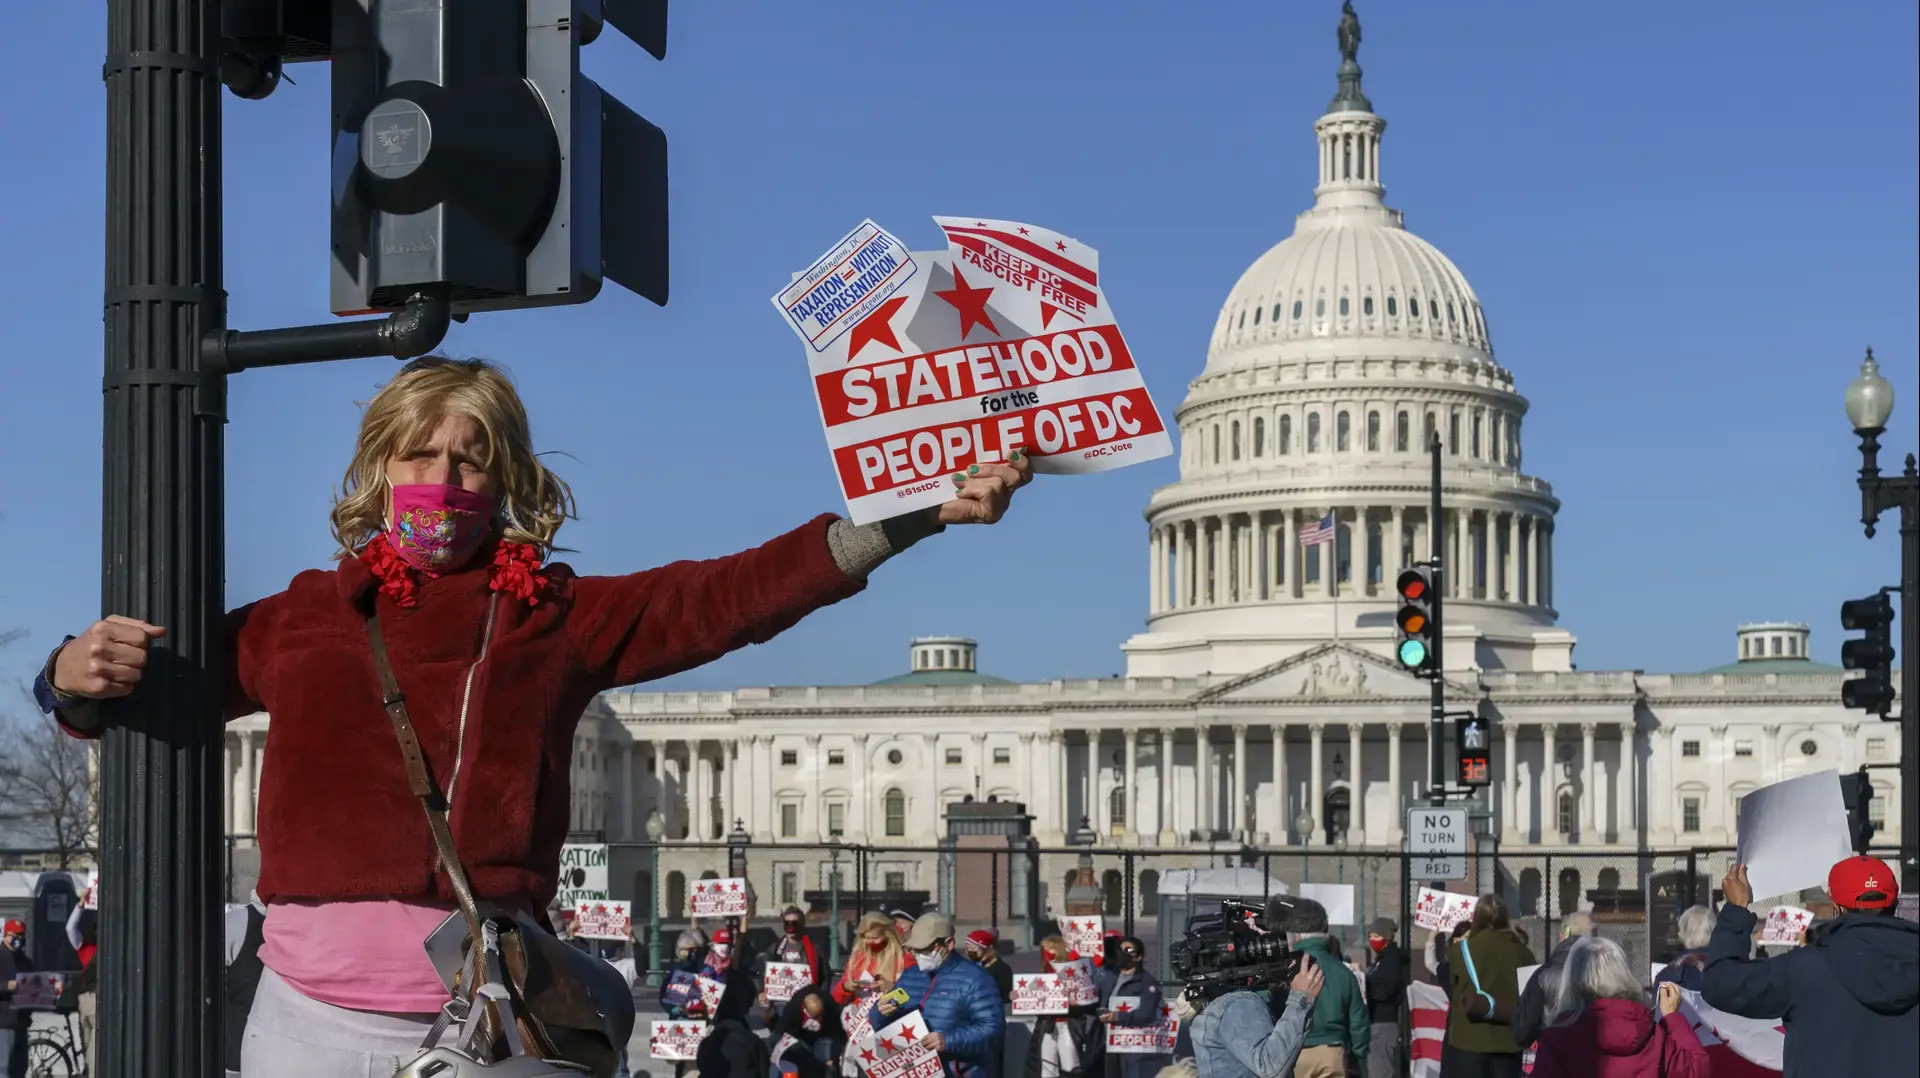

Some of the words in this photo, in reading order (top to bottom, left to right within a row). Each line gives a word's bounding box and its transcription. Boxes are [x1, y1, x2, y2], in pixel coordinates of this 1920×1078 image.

[806, 248, 851, 284] Washington,
[984, 243, 1032, 274] KEEP
[1038, 268, 1063, 289] DC
[791, 273, 846, 322] TAXATION
[850, 235, 893, 273] WITHOUT
[814, 253, 898, 327] REPRESENTATION
[962, 247, 1035, 291] FASCIST
[1041, 284, 1086, 315] FREE
[842, 281, 895, 326] www.dcvote.org
[841, 330, 1113, 417] STATEHOOD
[980, 396, 1009, 414] for
[1010, 389, 1039, 408] the
[855, 416, 1025, 491] PEOPLE
[1034, 404, 1085, 453] OF
[1087, 395, 1142, 441] DC
[1083, 442, 1133, 460] @DC_Vote
[896, 481, 940, 499] @51stDC
[1462, 757, 1487, 780] 32
[1424, 815, 1451, 829] NO
[1421, 832, 1455, 844] TURN
[1425, 863, 1451, 875] RED
[1864, 875, 1878, 888] dc
[579, 914, 625, 924] STATEHOOD
[1113, 1034, 1152, 1046] PEOPLE
[915, 1063, 929, 1078] OF
[926, 1058, 940, 1073] DC
